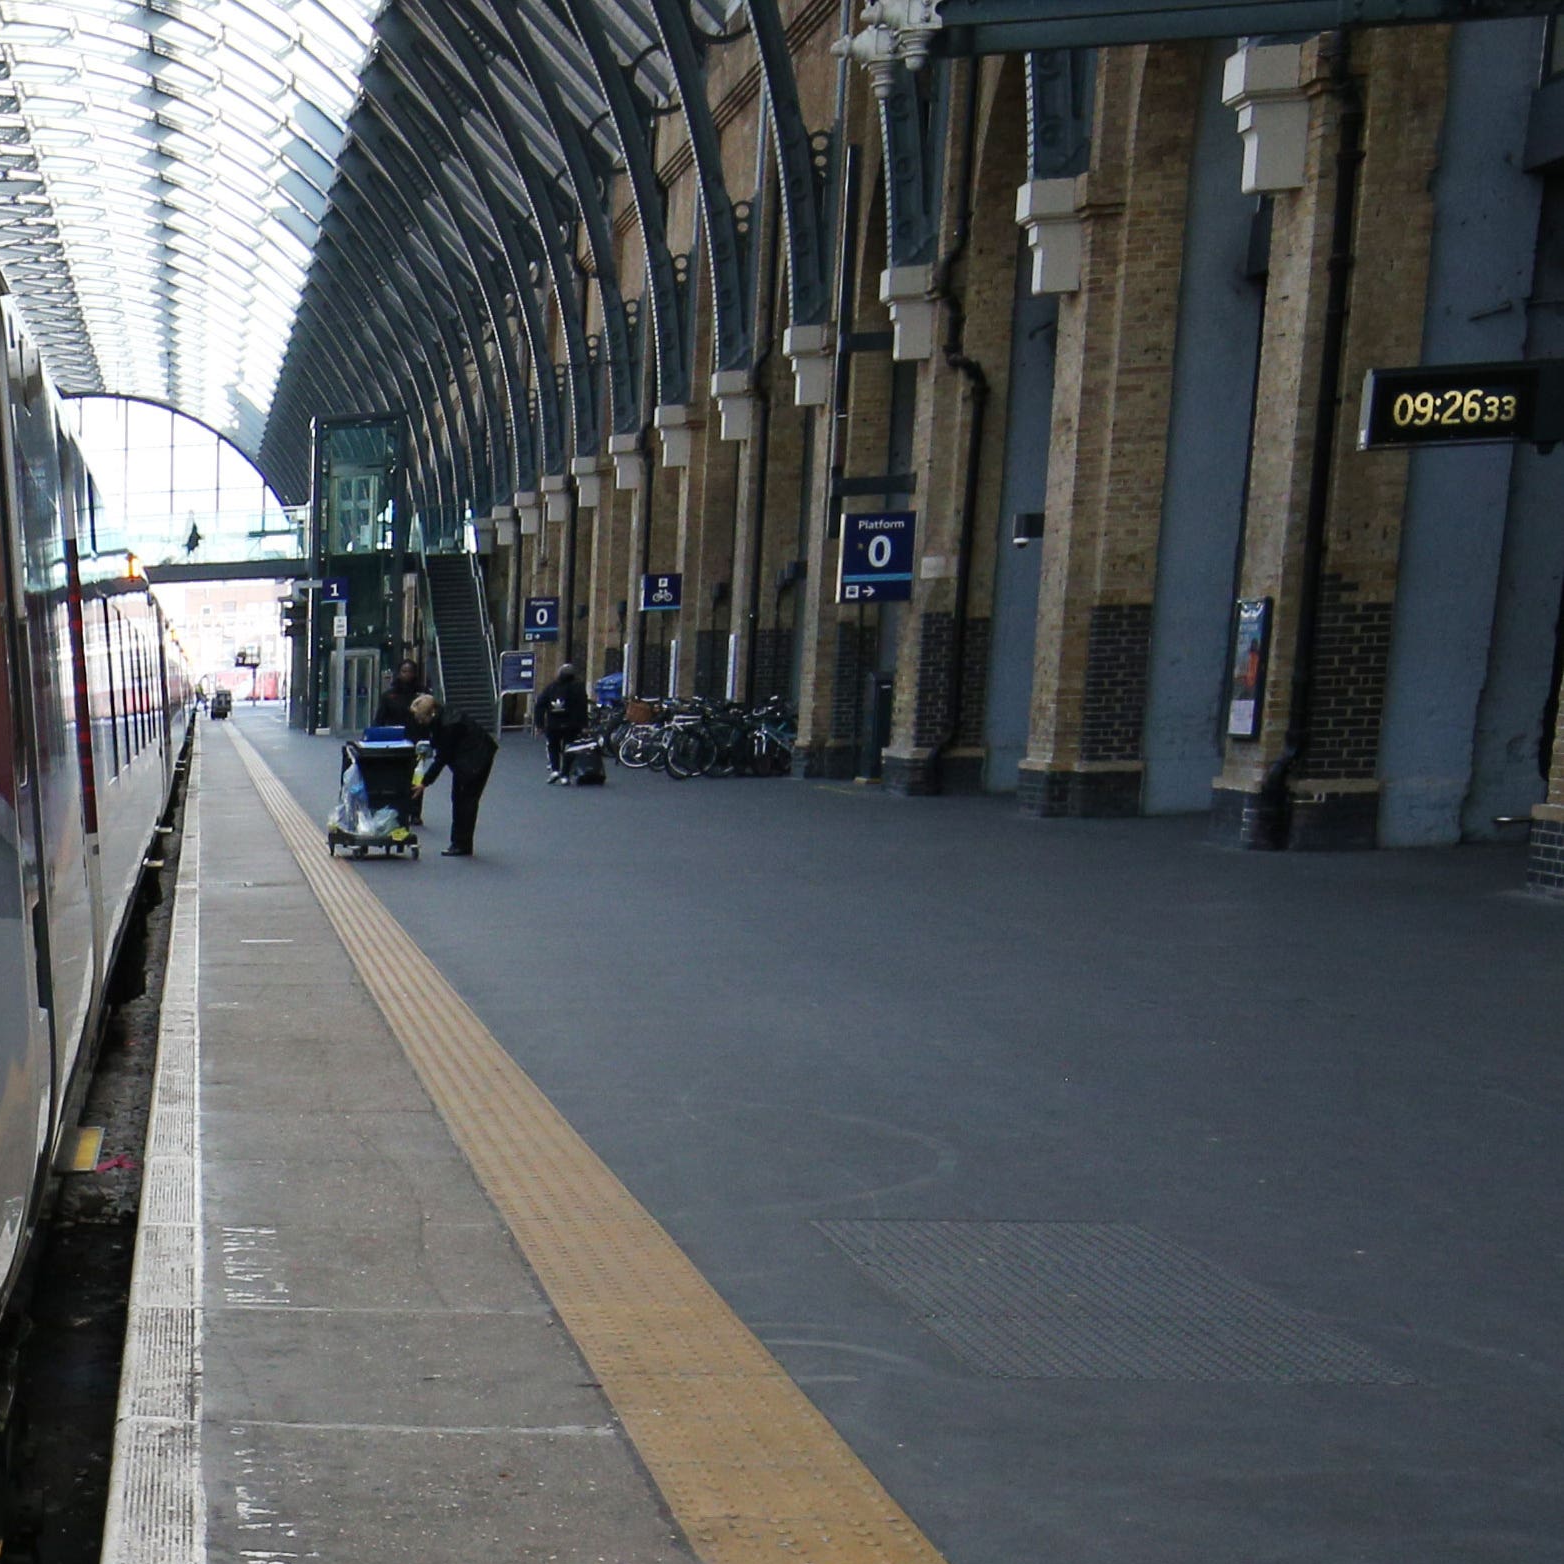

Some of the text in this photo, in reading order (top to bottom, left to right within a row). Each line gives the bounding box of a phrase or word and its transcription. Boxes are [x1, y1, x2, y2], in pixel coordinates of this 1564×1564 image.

[858, 519, 905, 530] Platform
[868, 534, 892, 568] 0
[330, 583, 340, 597] 1
[536, 608, 548, 625] 0
